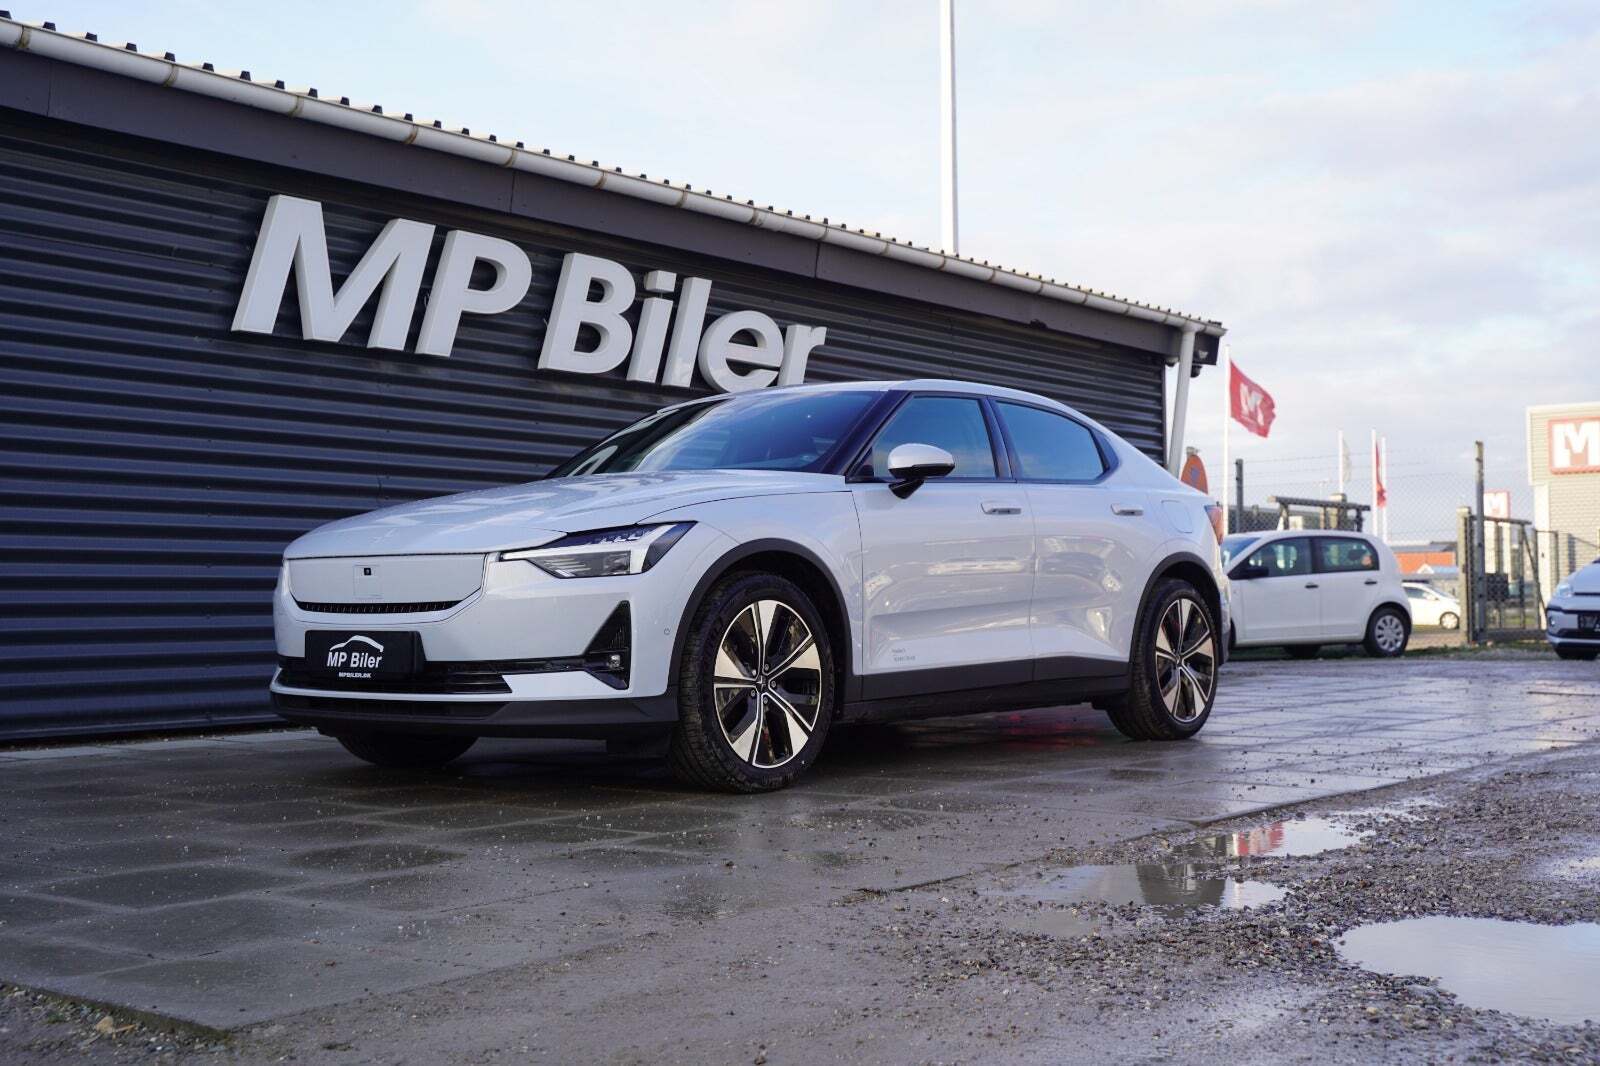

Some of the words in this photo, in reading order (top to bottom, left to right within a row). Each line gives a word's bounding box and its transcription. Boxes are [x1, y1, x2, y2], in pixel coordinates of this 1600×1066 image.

[231, 194, 532, 358] MP
[537, 252, 827, 394] Biler
[1552, 422, 1600, 468] M
[327, 651, 347, 667] MP
[350, 652, 383, 668] Biler
